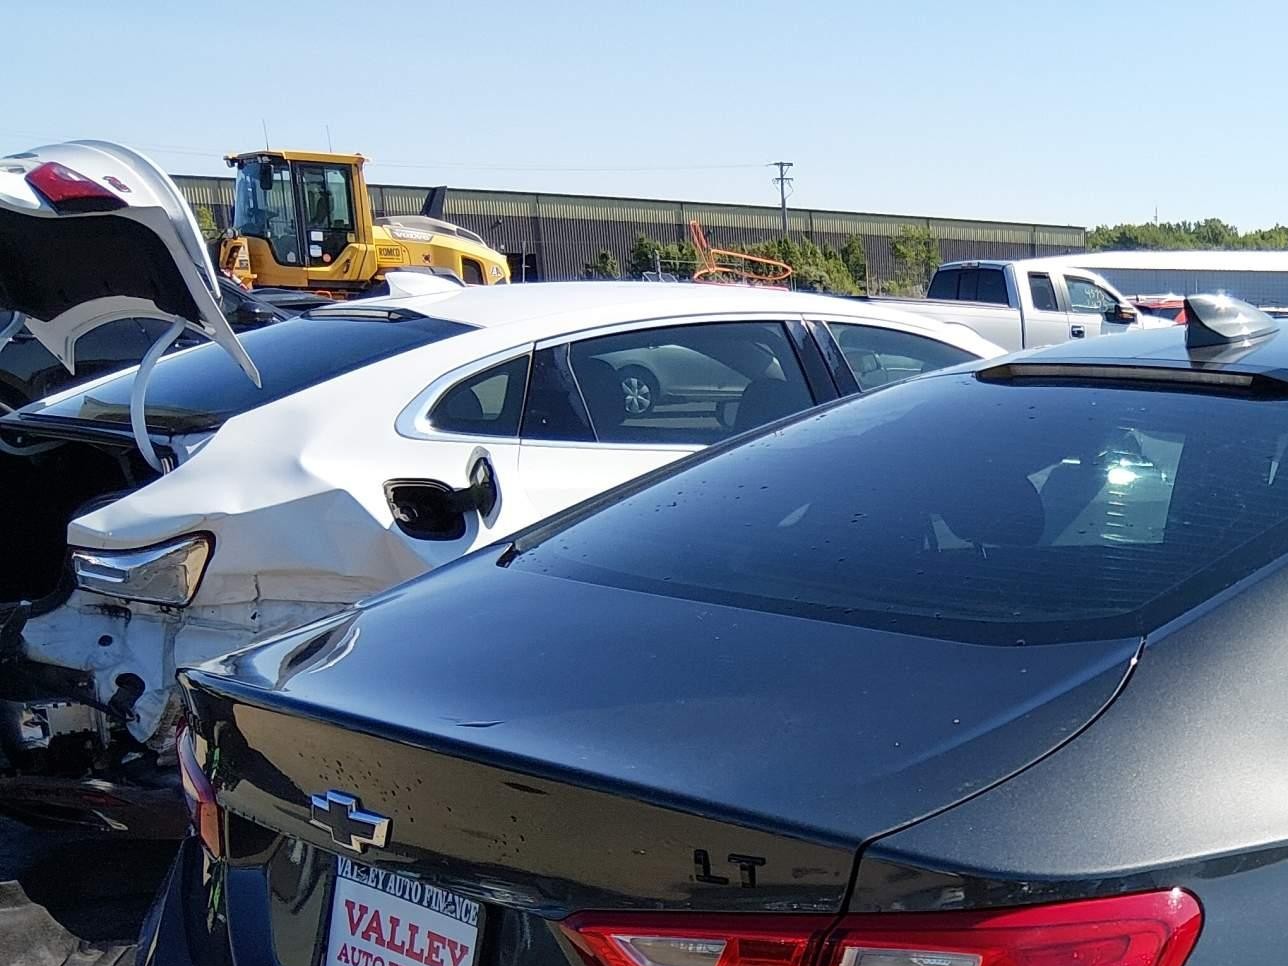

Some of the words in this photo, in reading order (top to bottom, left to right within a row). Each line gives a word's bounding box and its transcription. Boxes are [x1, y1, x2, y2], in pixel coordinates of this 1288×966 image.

[693, 848, 766, 889] LT
[386, 872, 422, 903] AUTO
[423, 884, 480, 925] FINANCE
